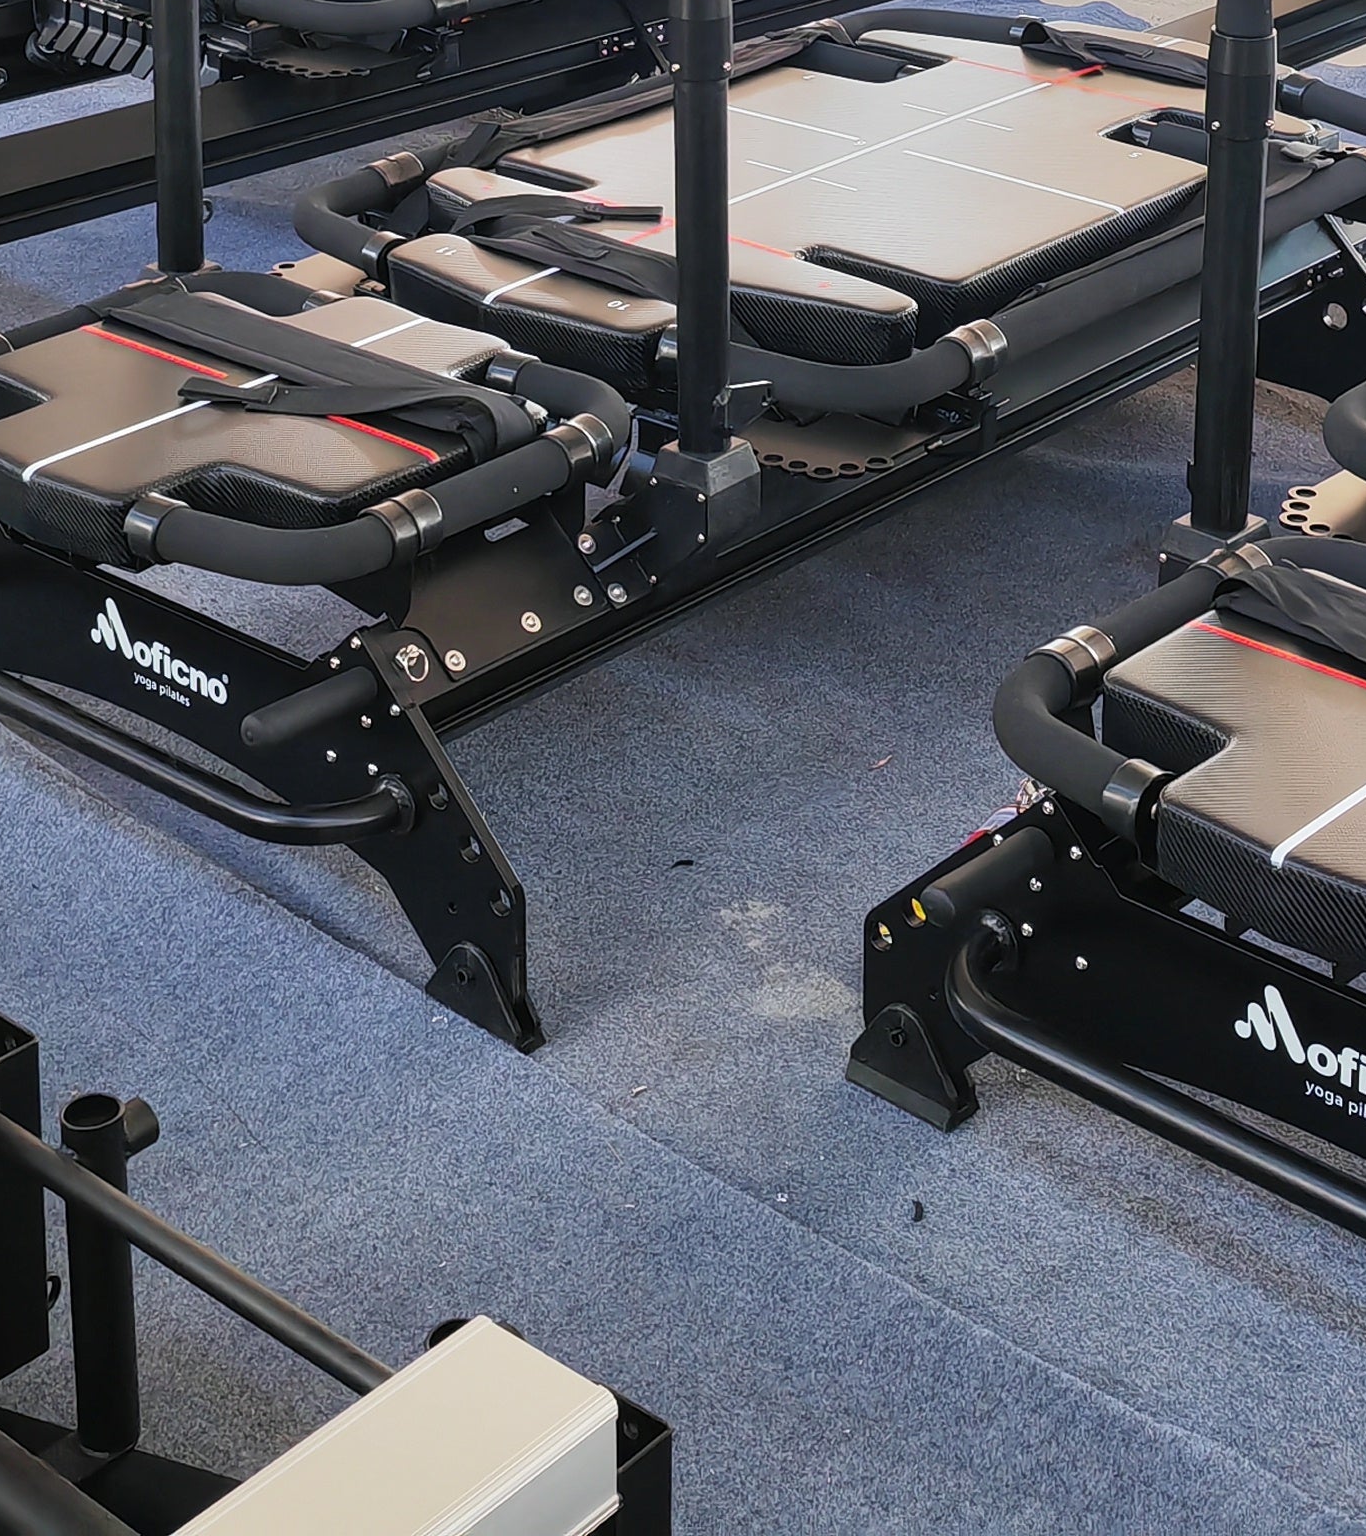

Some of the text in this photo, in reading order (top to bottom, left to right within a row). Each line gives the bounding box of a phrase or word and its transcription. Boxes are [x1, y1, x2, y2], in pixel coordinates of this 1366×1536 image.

[607, 300, 631, 311] 10
[133, 672, 191, 707] yoga pilates
[1304, 1079, 1344, 1108] yoga
